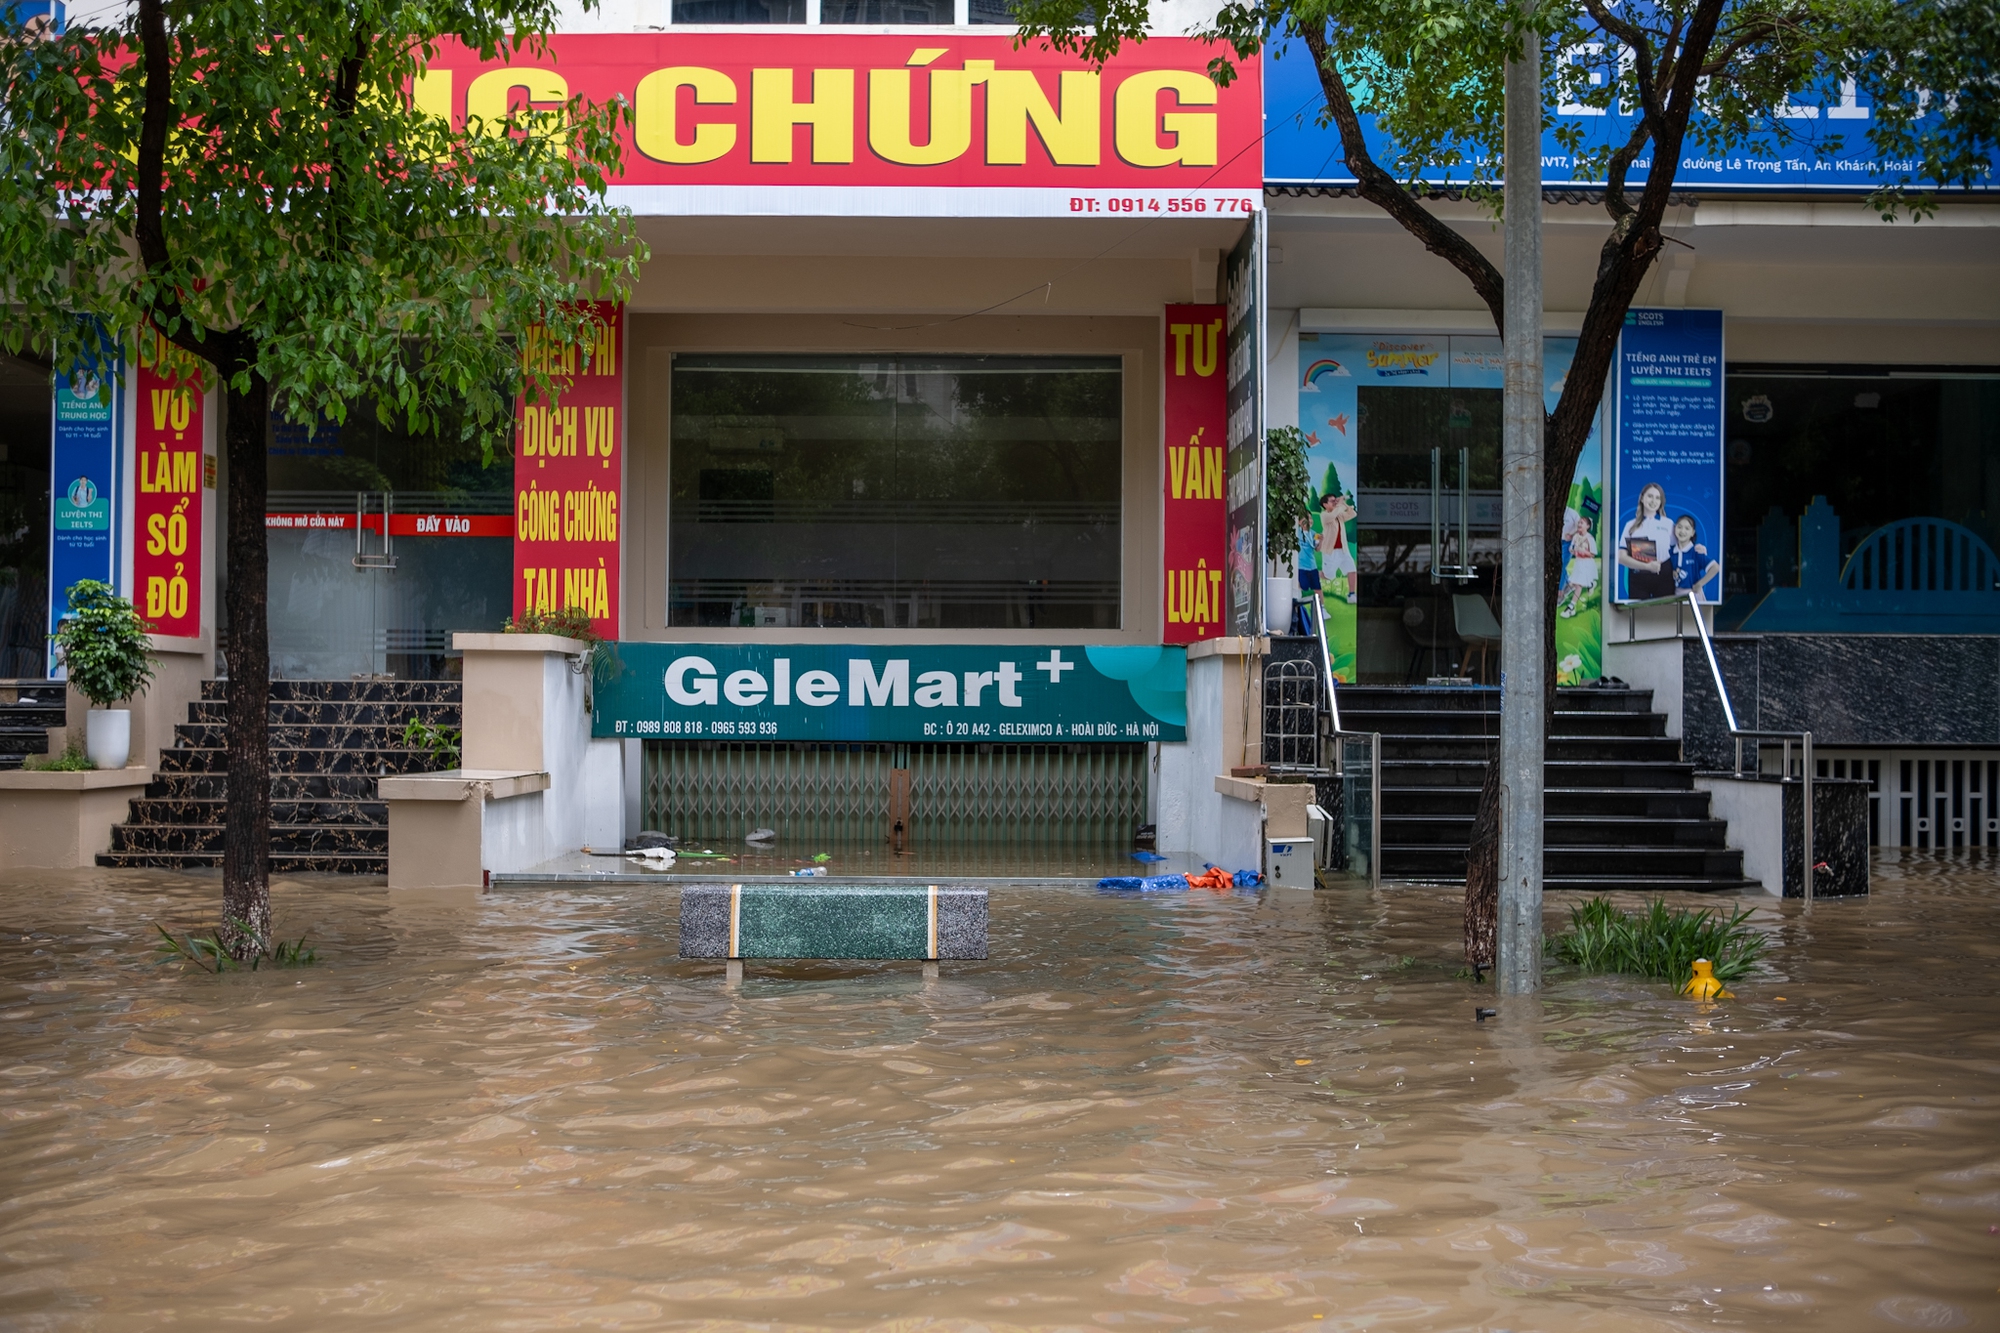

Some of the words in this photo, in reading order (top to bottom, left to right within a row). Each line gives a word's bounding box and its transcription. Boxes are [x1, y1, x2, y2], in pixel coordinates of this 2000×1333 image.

[634, 48, 1218, 167] CHỨNG
[1682, 158, 1723, 172] đường
[1726, 158, 1742, 170] Lê
[1745, 159, 1781, 173] Trọng
[1785, 158, 1811, 172] Tấn,
[1814, 159, 1831, 171] An
[1836, 160, 1880, 172] Khánh,
[1884, 160, 1912, 171] Hoài
[1070, 198, 1101, 213] ĐT:
[1108, 198, 1160, 213] 0914
[1167, 198, 1206, 213] 556
[1214, 198, 1253, 213] 776
[1638, 312, 1664, 320] SCOTS
[1170, 318, 1223, 377] TƯ
[1378, 341, 1425, 351] Discover
[1366, 349, 1439, 369] Summer
[1626, 351, 1656, 362] TIẾNG
[1659, 354, 1680, 363] ANH
[1682, 353, 1700, 364] TRẺ
[1702, 355, 1716, 364] EM
[1631, 364, 1662, 376] LUYỆN
[1664, 366, 1681, 375] THI
[1685, 367, 1711, 376] IELTS
[62, 400, 87, 409] TIẾNG
[151, 388, 190, 440] VỤ
[61, 411, 88, 419] TRUNG
[90, 411, 107, 420] HỌC
[523, 406, 578, 468] DỊCH
[584, 406, 614, 468] VỤ
[141, 442, 197, 494] LÀM
[1169, 427, 1223, 499] VẤN
[61, 510, 87, 519] LUYỆN
[518, 479, 560, 542] CÔNG
[564, 480, 617, 542] CHỨNG
[1390, 501, 1419, 510] SCOTS
[146, 496, 190, 556] SỔ
[265, 515, 293, 527] KHÔNG
[295, 514, 308, 527] MỞ
[310, 513, 327, 527] CỬA
[328, 515, 345, 527] NÀY
[416, 514, 441, 533] ĐẨY
[445, 516, 470, 533] VÀO
[146, 562, 188, 618] ĐỎ
[564, 557, 609, 619] NHÀ
[1168, 558, 1222, 635] LUẬT
[664, 655, 1023, 707] GeleMart
[615, 720, 628, 732] ĐT
[636, 720, 660, 733] 0989
[664, 721, 681, 733] 808
[684, 721, 702, 733] 818
[711, 721, 734, 734] 0965
[738, 721, 756, 734] 593
[759, 722, 777, 734] 936
[924, 722, 937, 735] ĐC
[946, 720, 953, 735] Ô
[956, 723, 968, 735] 20
[972, 723, 990, 735] A42
[999, 722, 1052, 735] GELEXIMCO
[1056, 723, 1063, 735] A
[1072, 721, 1094, 736] HOÀI
[1098, 719, 1117, 736] ĐỨC
[1126, 721, 1139, 736] HÀ
[1142, 720, 1159, 738] NỘI
